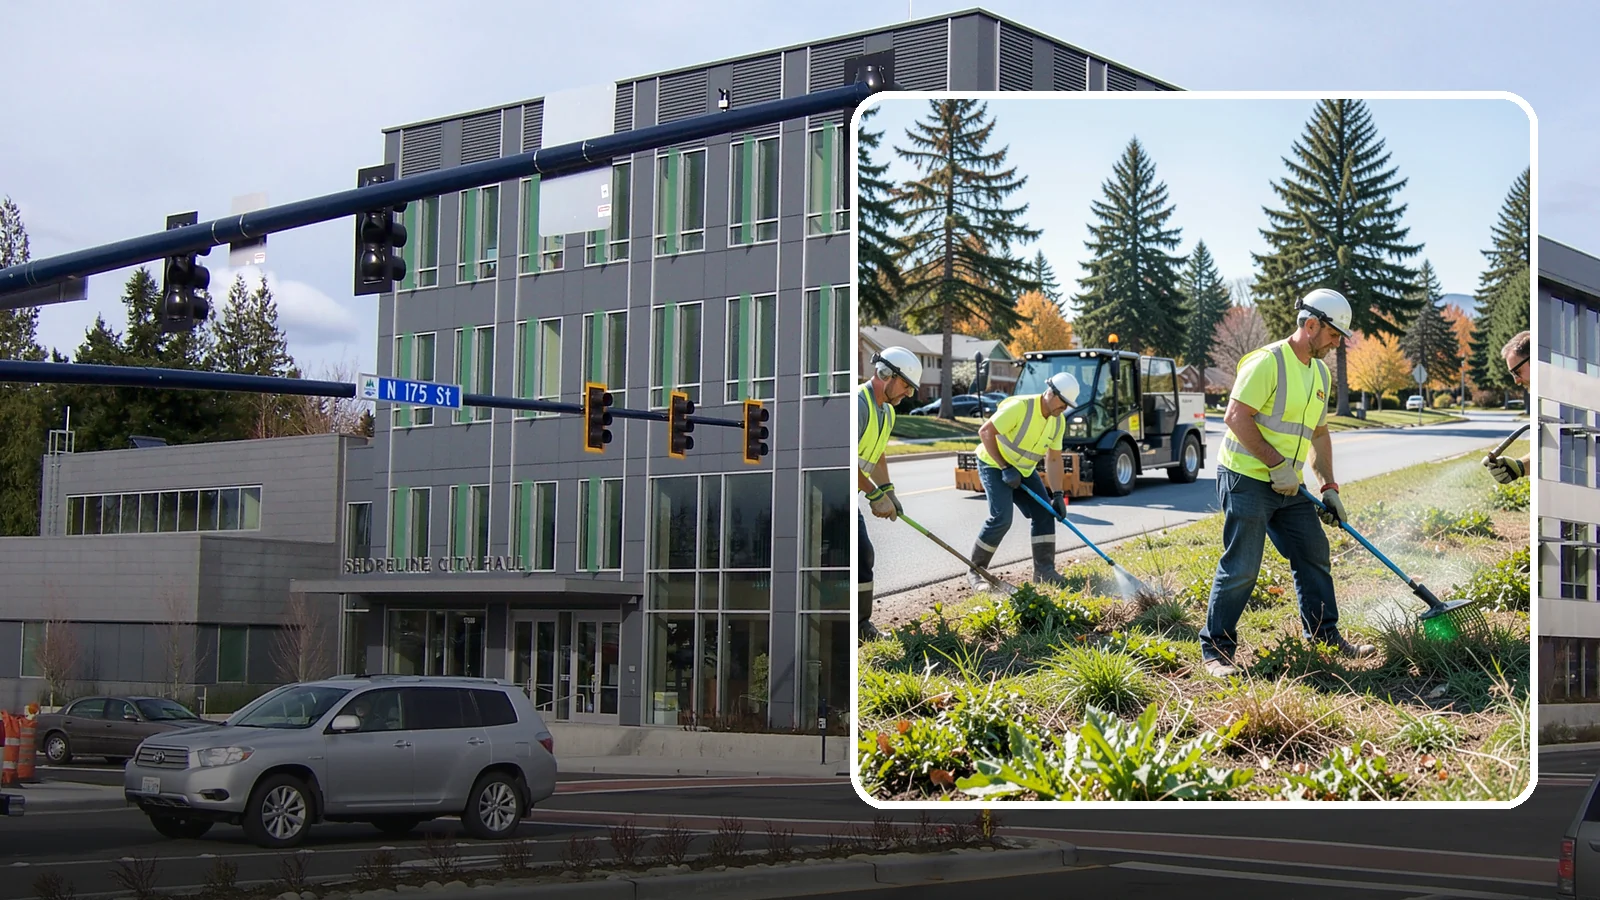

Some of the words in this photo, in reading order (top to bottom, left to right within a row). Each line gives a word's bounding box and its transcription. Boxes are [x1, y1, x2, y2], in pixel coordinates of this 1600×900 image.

[387, 380, 396, 399] N
[405, 382, 427, 403] 175
[436, 386, 451, 406] St
[344, 557, 431, 574] SHORELINE
[438, 556, 475, 572] CITY
[484, 555, 525, 572] HALL
